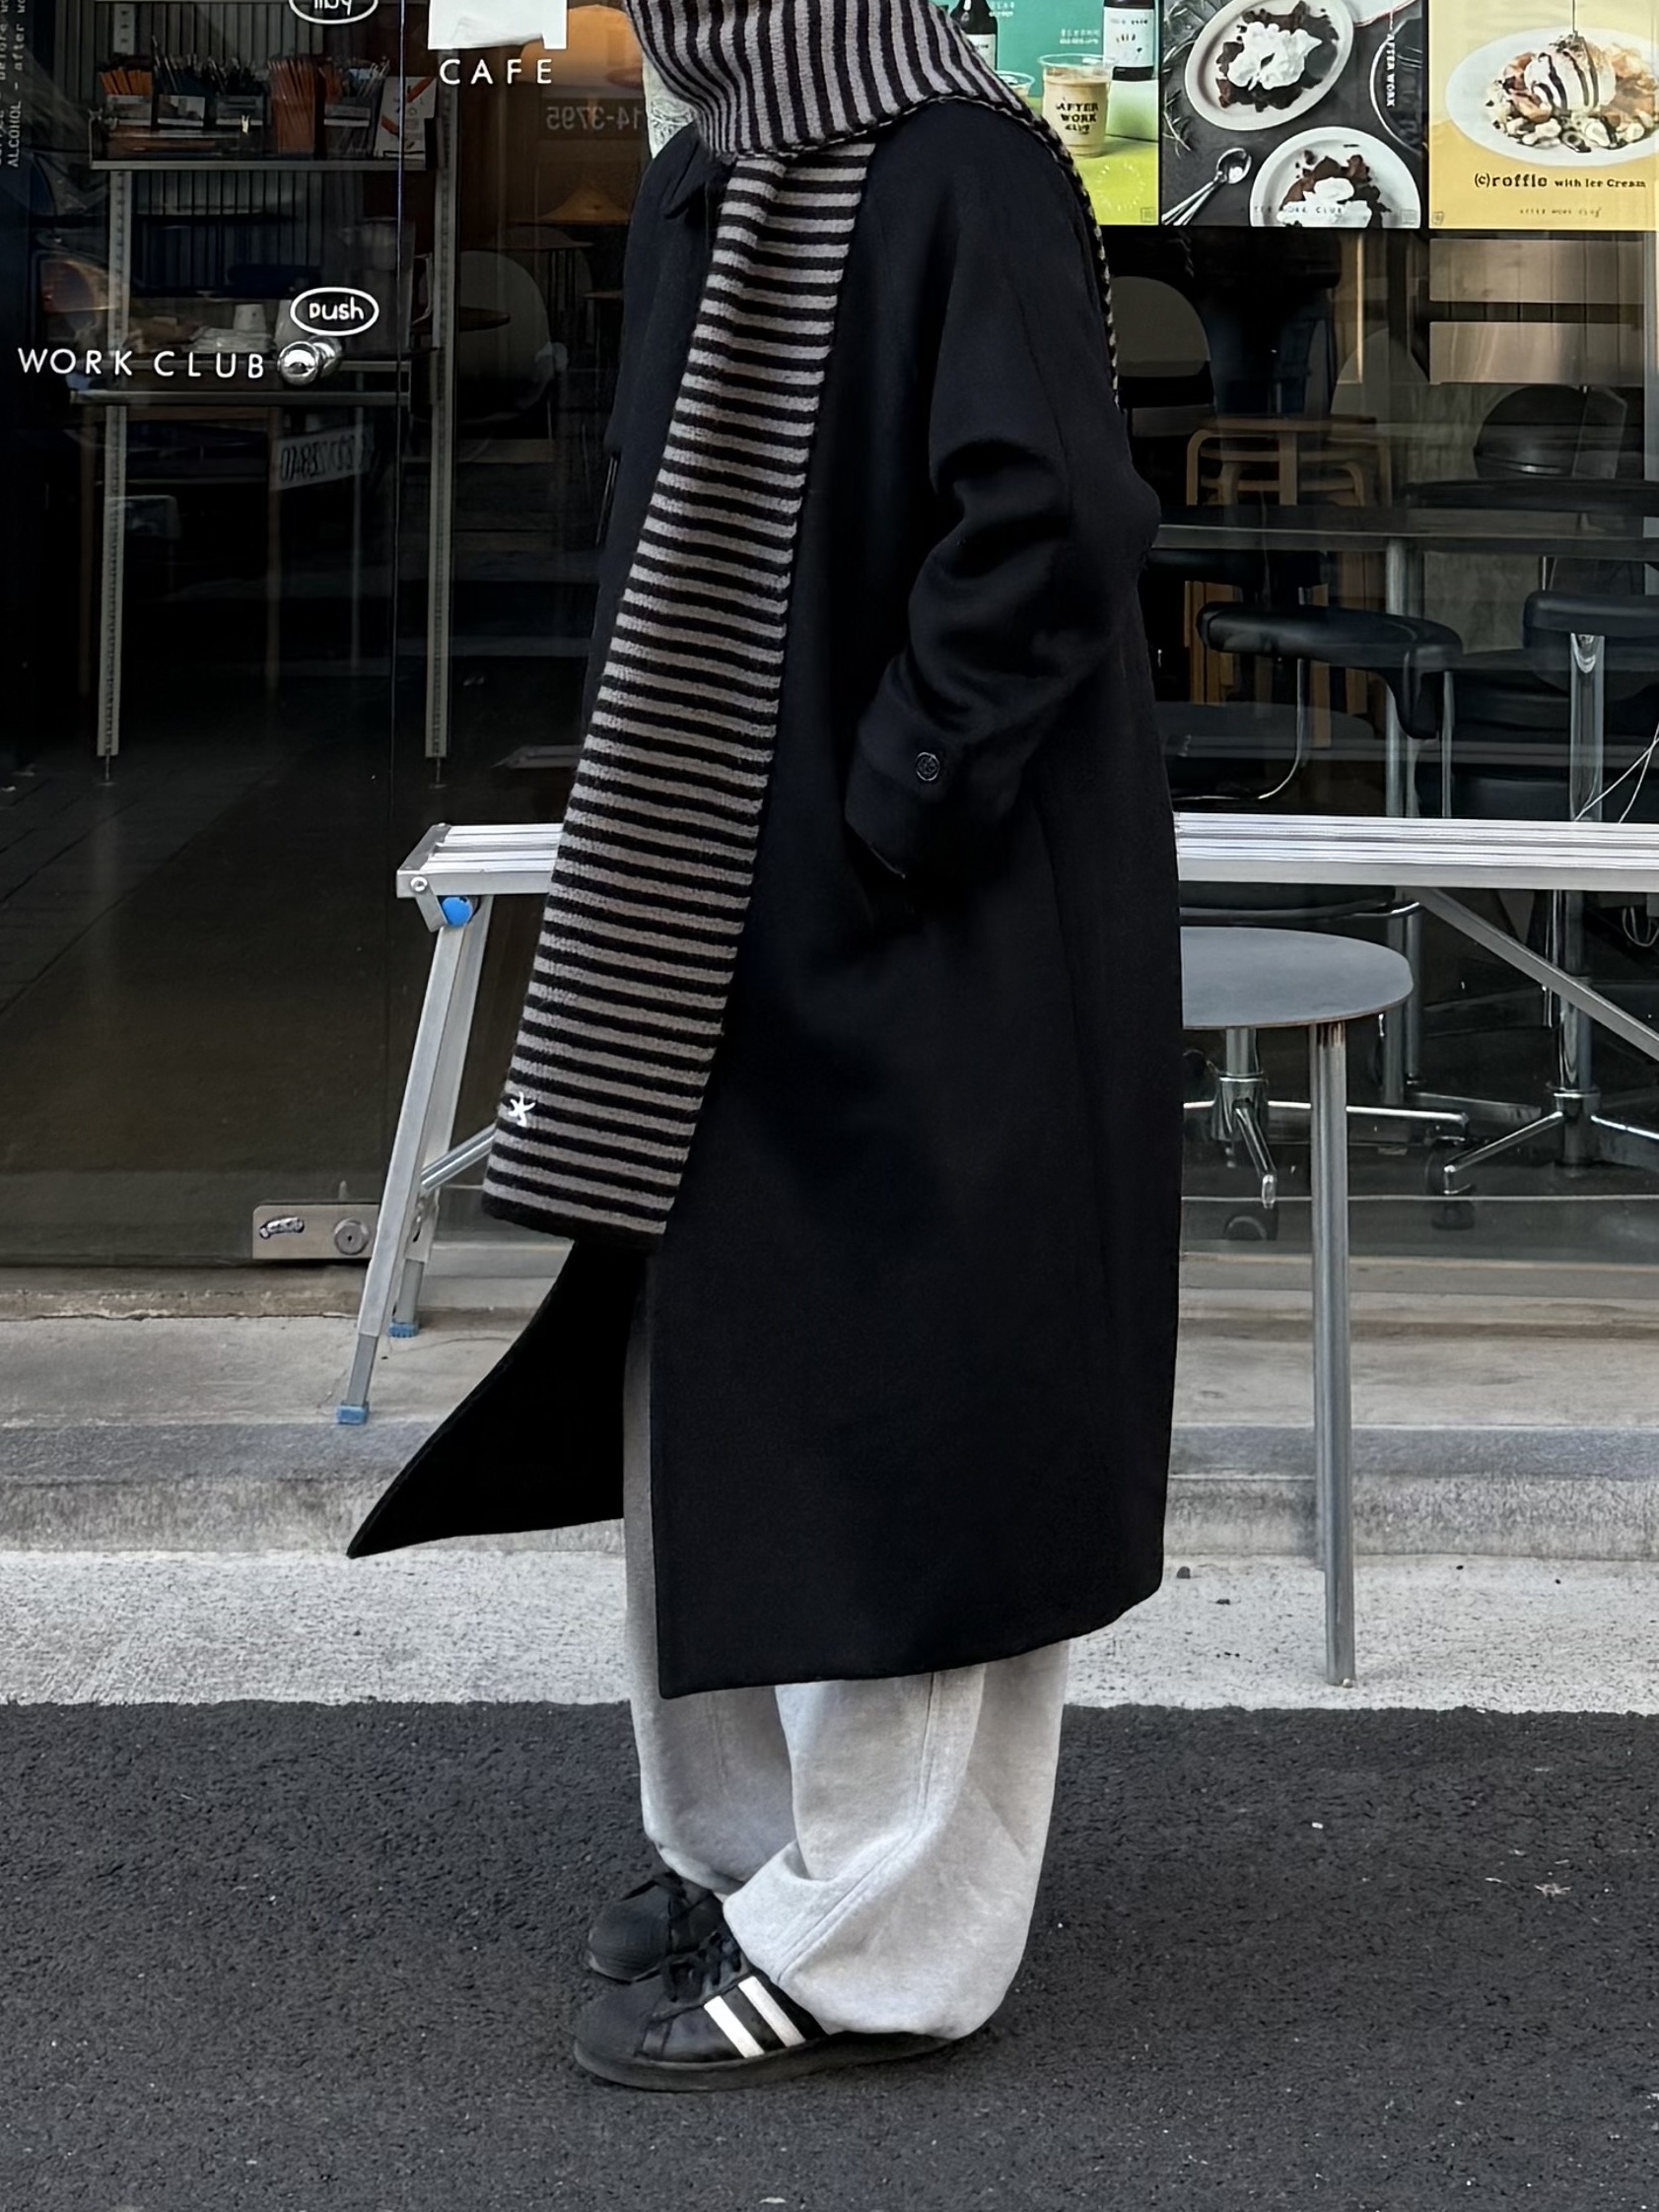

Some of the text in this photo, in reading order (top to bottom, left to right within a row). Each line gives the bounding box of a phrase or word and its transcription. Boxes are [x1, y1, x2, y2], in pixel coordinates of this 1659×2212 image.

[13, 24, 25, 71] after
[440, 59, 552, 85] CAFE
[1386, 34, 1395, 106] AFTER WORK
[1056, 103, 1099, 111] AFTER
[1061, 113, 1096, 122] WORK
[309, 296, 365, 320] push
[18, 348, 265, 379] WORK CLUB
